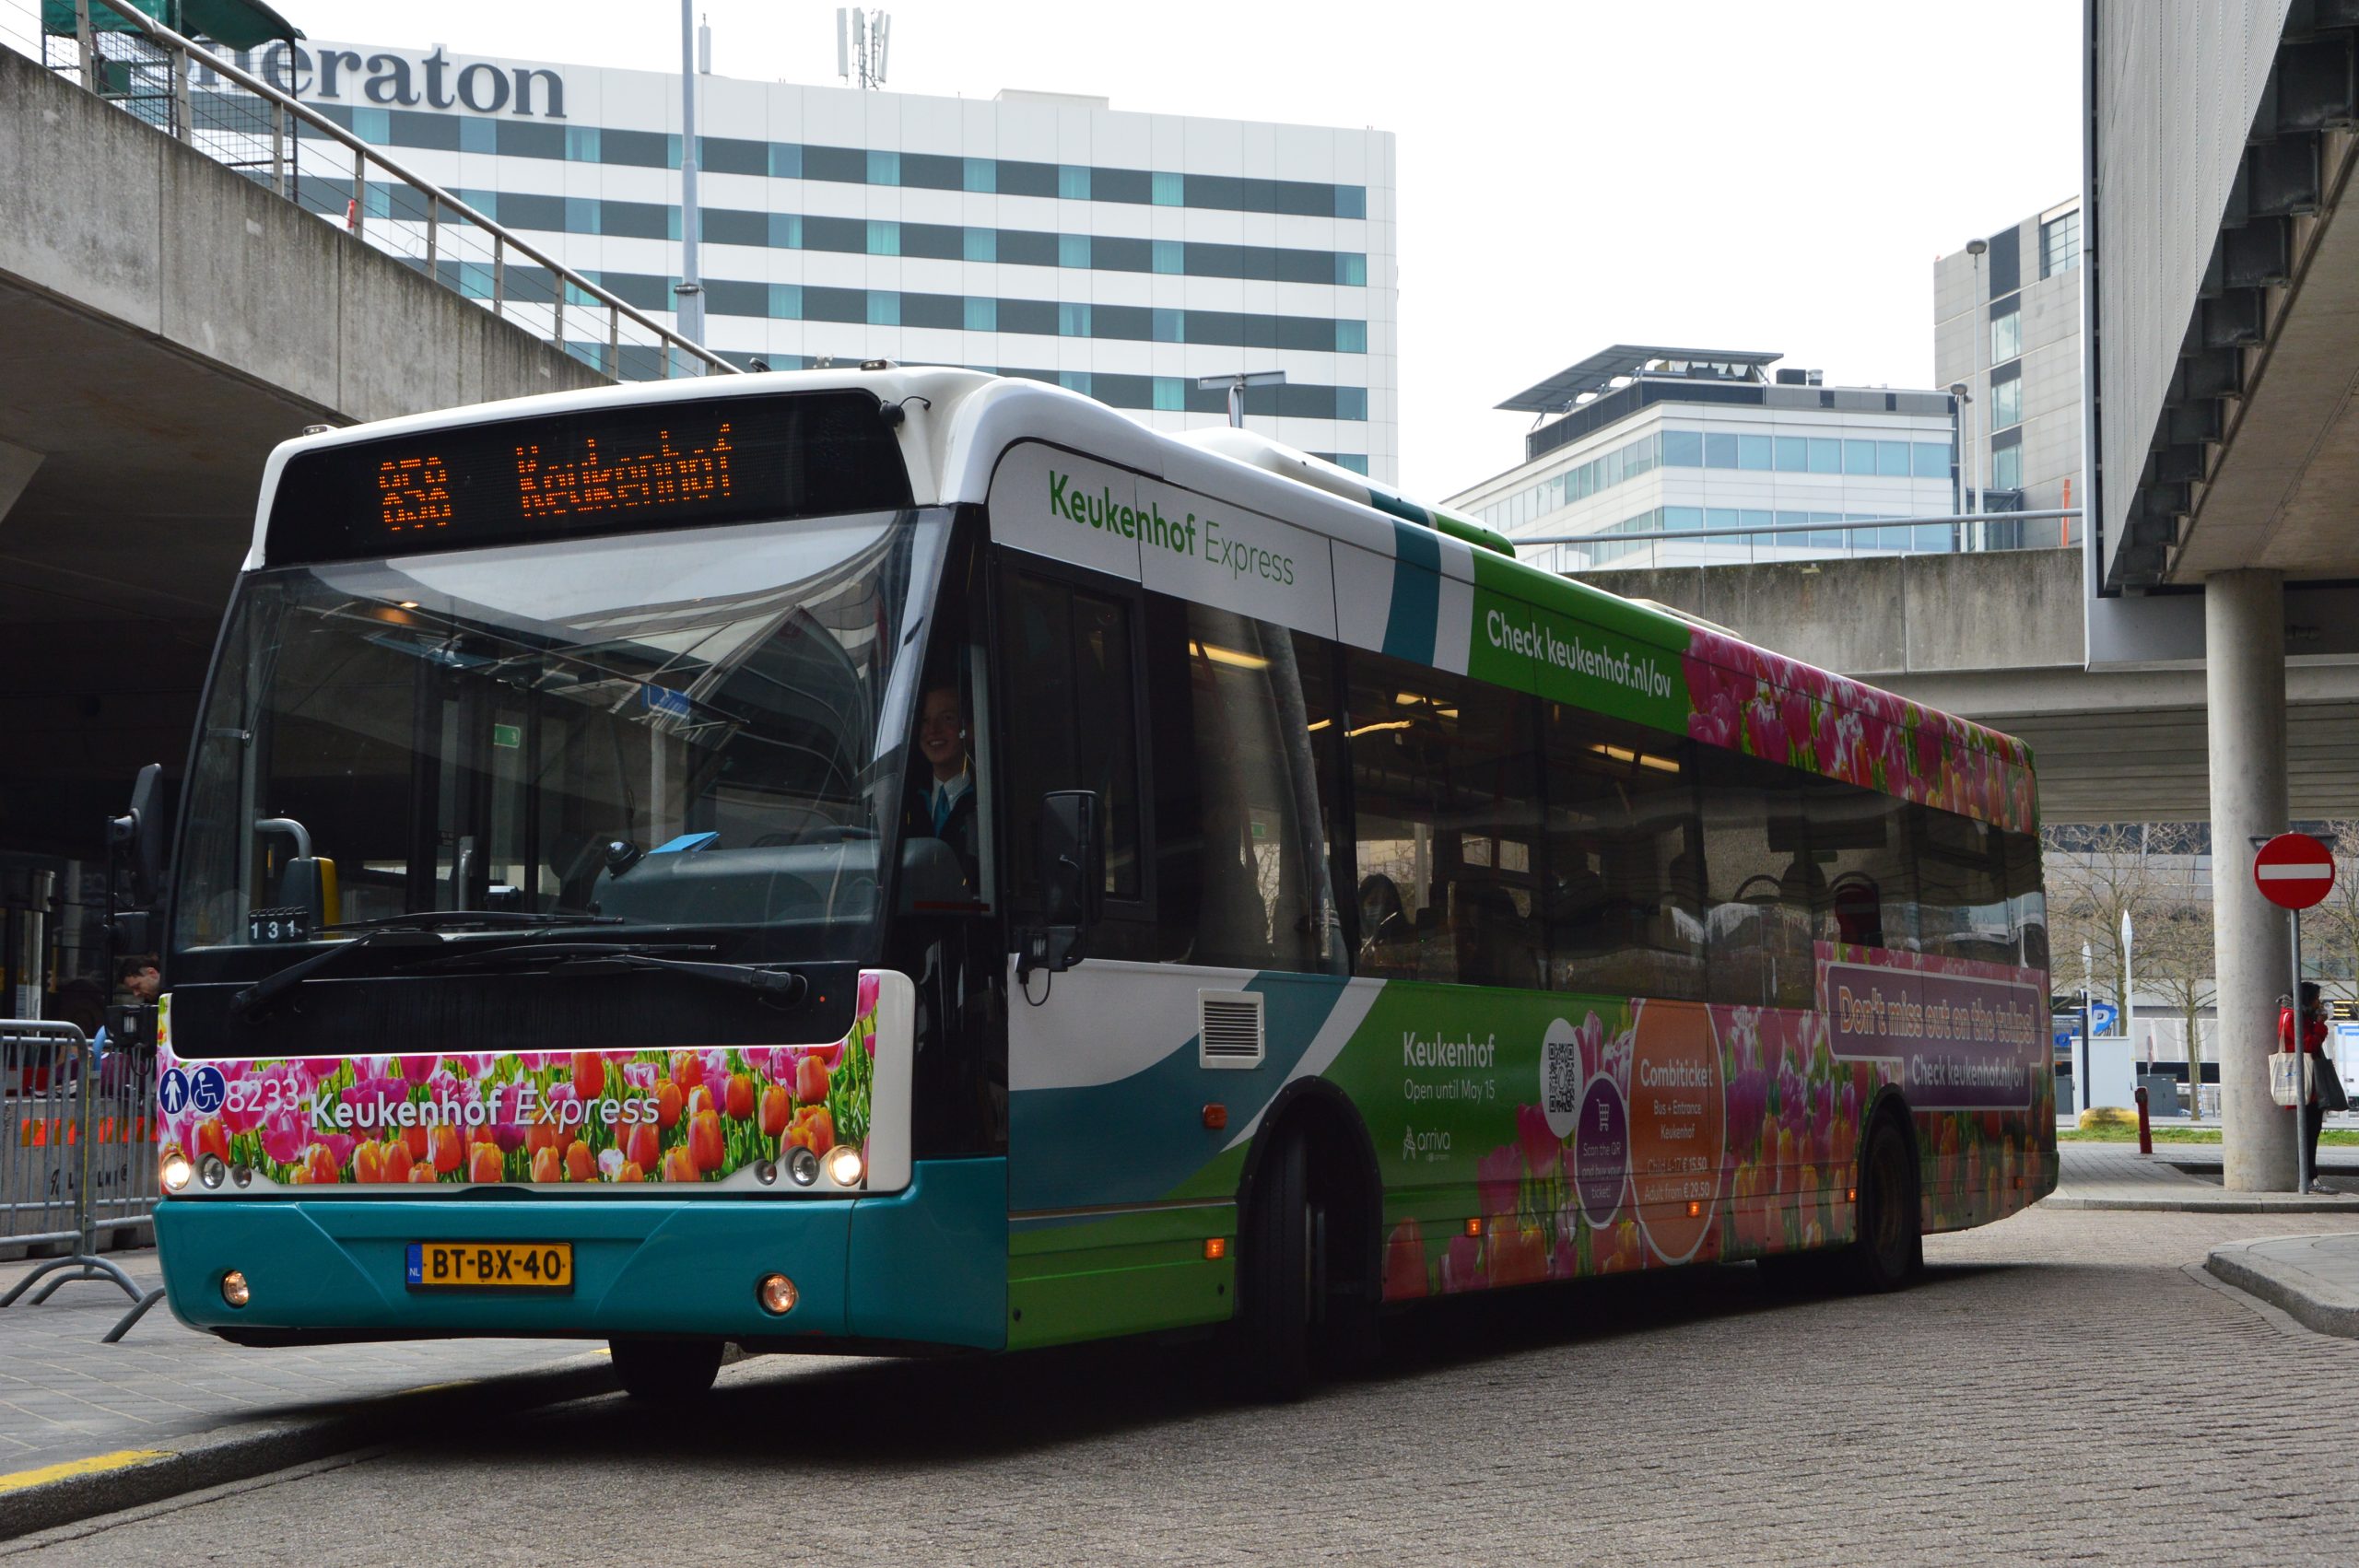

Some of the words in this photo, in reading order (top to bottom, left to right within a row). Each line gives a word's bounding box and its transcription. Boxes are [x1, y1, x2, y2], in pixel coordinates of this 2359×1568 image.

[516, 423, 732, 517] Keukenhof
[1050, 470, 1196, 555] Keukenhof
[1205, 520, 1294, 585] Express
[1486, 609, 1543, 661] Check
[1546, 626, 1671, 698] keukenhof.nl/ov
[1838, 986, 1886, 1036] Don't
[1887, 989, 1923, 1038] miss
[1925, 999, 1952, 1040] out
[1953, 1006, 1970, 1041] on
[1971, 998, 1995, 1042] the
[1996, 1001, 2035, 1053] tulips!
[1403, 1031, 1495, 1068] Keukenhof
[1640, 1058, 1713, 1087] Combiticket
[1911, 1054, 1944, 1086] Check
[1947, 1055, 2025, 1091] keukenhof.nl/ov
[226, 1078, 299, 1112] 8233
[1404, 1078, 1433, 1105] Open
[1436, 1079, 1459, 1099] until
[1461, 1079, 1483, 1106] May
[1485, 1079, 1495, 1099] 15
[1653, 1099, 1666, 1115] Bus
[1672, 1099, 1702, 1115] Entrance
[311, 1089, 502, 1128] Keukenhof
[514, 1088, 661, 1134] Express
[1417, 1128, 1451, 1151] arriva
[1661, 1123, 1695, 1140] Keukenhof
[1583, 1142, 1599, 1156] Scan
[1600, 1141, 1610, 1156] the
[1611, 1141, 1621, 1155] QR
[1648, 1157, 1665, 1174] Child
[1645, 1184, 1664, 1201] Adult
[1665, 1183, 1682, 1199] from
[409, 1268, 420, 1277] NL
[433, 1249, 561, 1280] BT-BX-40
